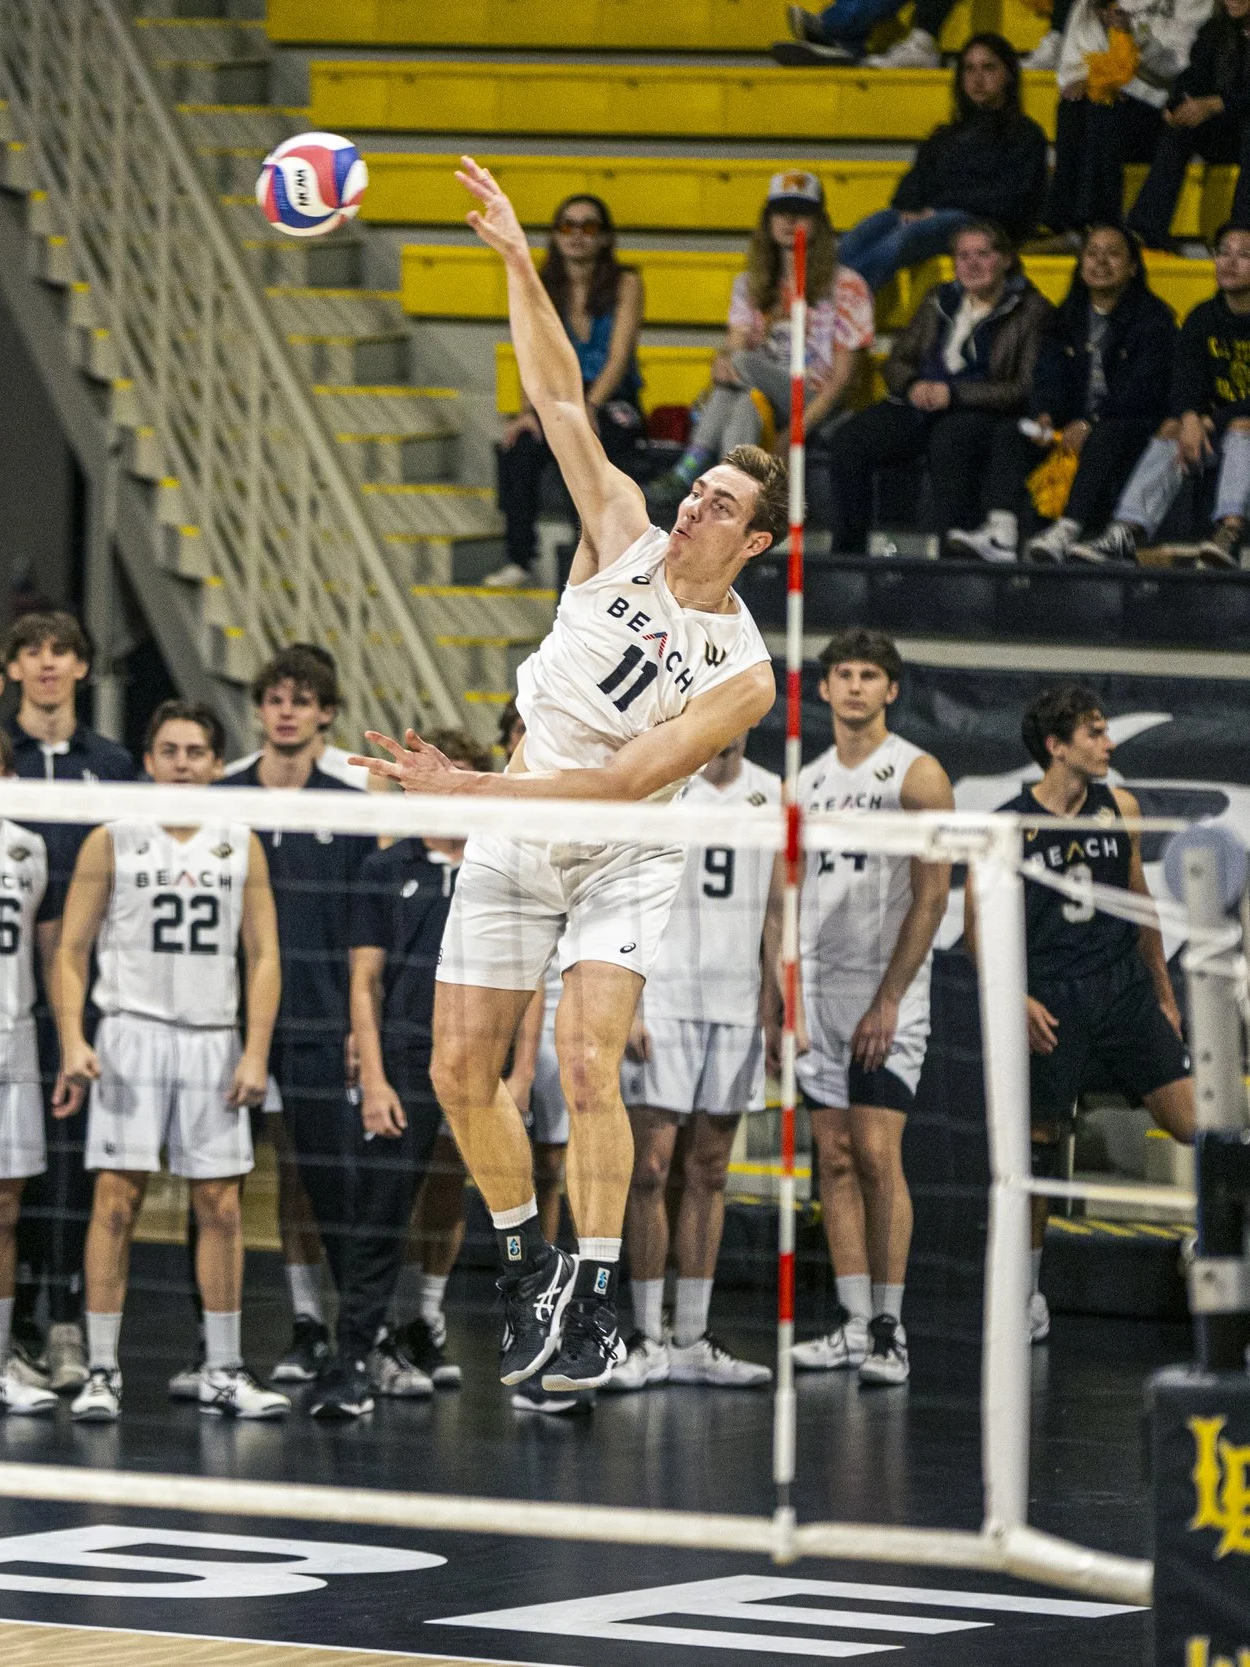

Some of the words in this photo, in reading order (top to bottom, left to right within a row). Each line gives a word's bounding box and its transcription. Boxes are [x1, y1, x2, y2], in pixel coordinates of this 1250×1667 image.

[606, 596, 694, 694] BEACH
[597, 643, 658, 713] 11
[135, 869, 232, 892] BEACH
[703, 846, 736, 899] 9
[152, 893, 219, 956] 22
